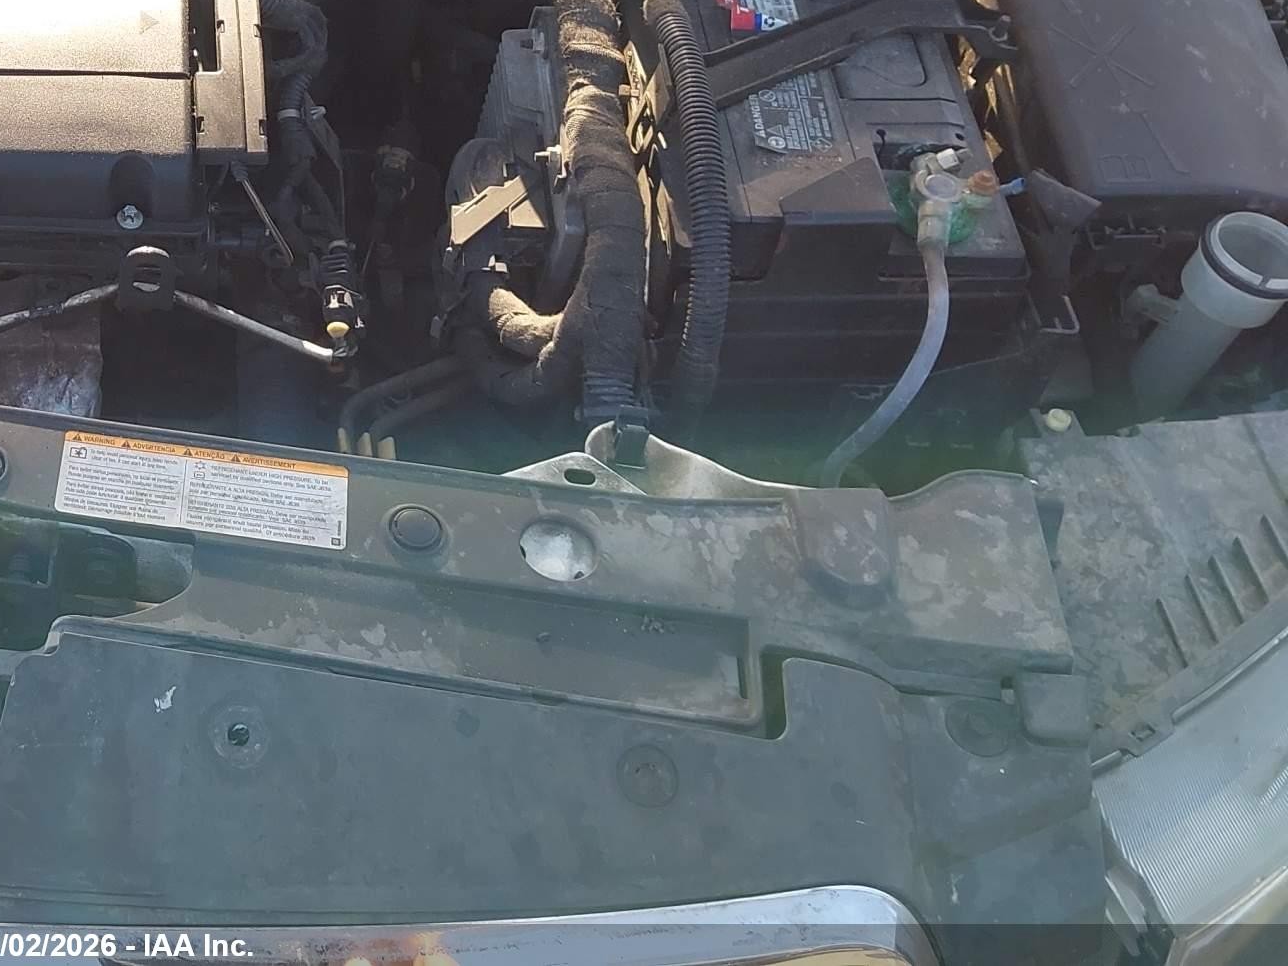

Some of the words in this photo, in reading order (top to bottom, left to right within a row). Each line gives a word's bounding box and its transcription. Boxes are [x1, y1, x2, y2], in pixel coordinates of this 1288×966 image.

[84, 435, 116, 446] WARNING
[132, 442, 176, 453] ADVERTENCIA
[194, 450, 226, 461] ATENÇÃO
[242, 456, 297, 469] AVERTISSEMENT
